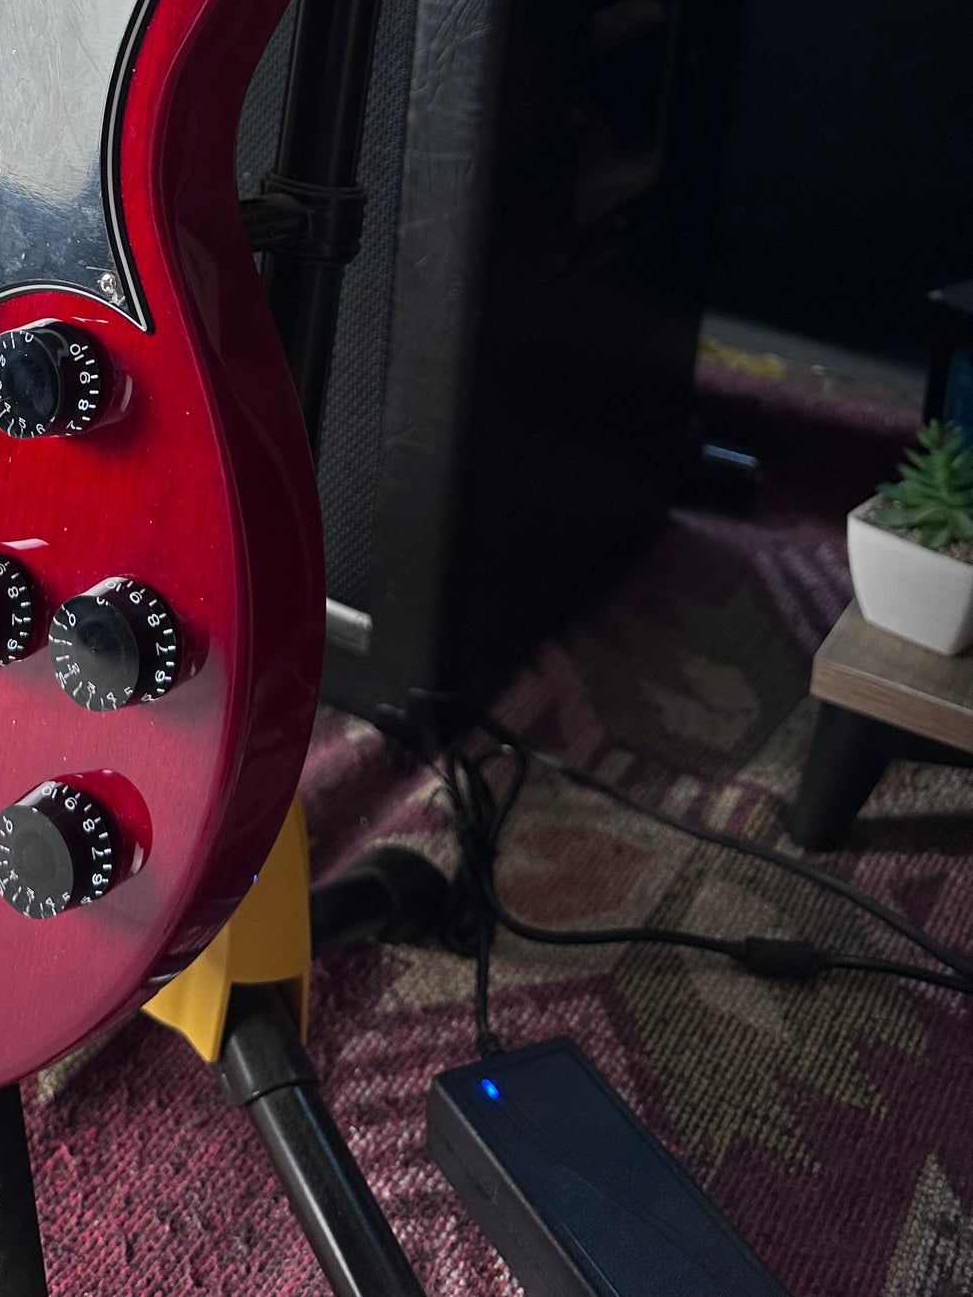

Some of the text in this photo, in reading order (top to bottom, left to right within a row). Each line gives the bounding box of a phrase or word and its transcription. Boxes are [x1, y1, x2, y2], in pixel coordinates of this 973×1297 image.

[77, 398, 89, 411] 8
[7, 586, 19, 598] 8
[147, 613, 160, 627] 8
[82, 818, 95, 832] 8
